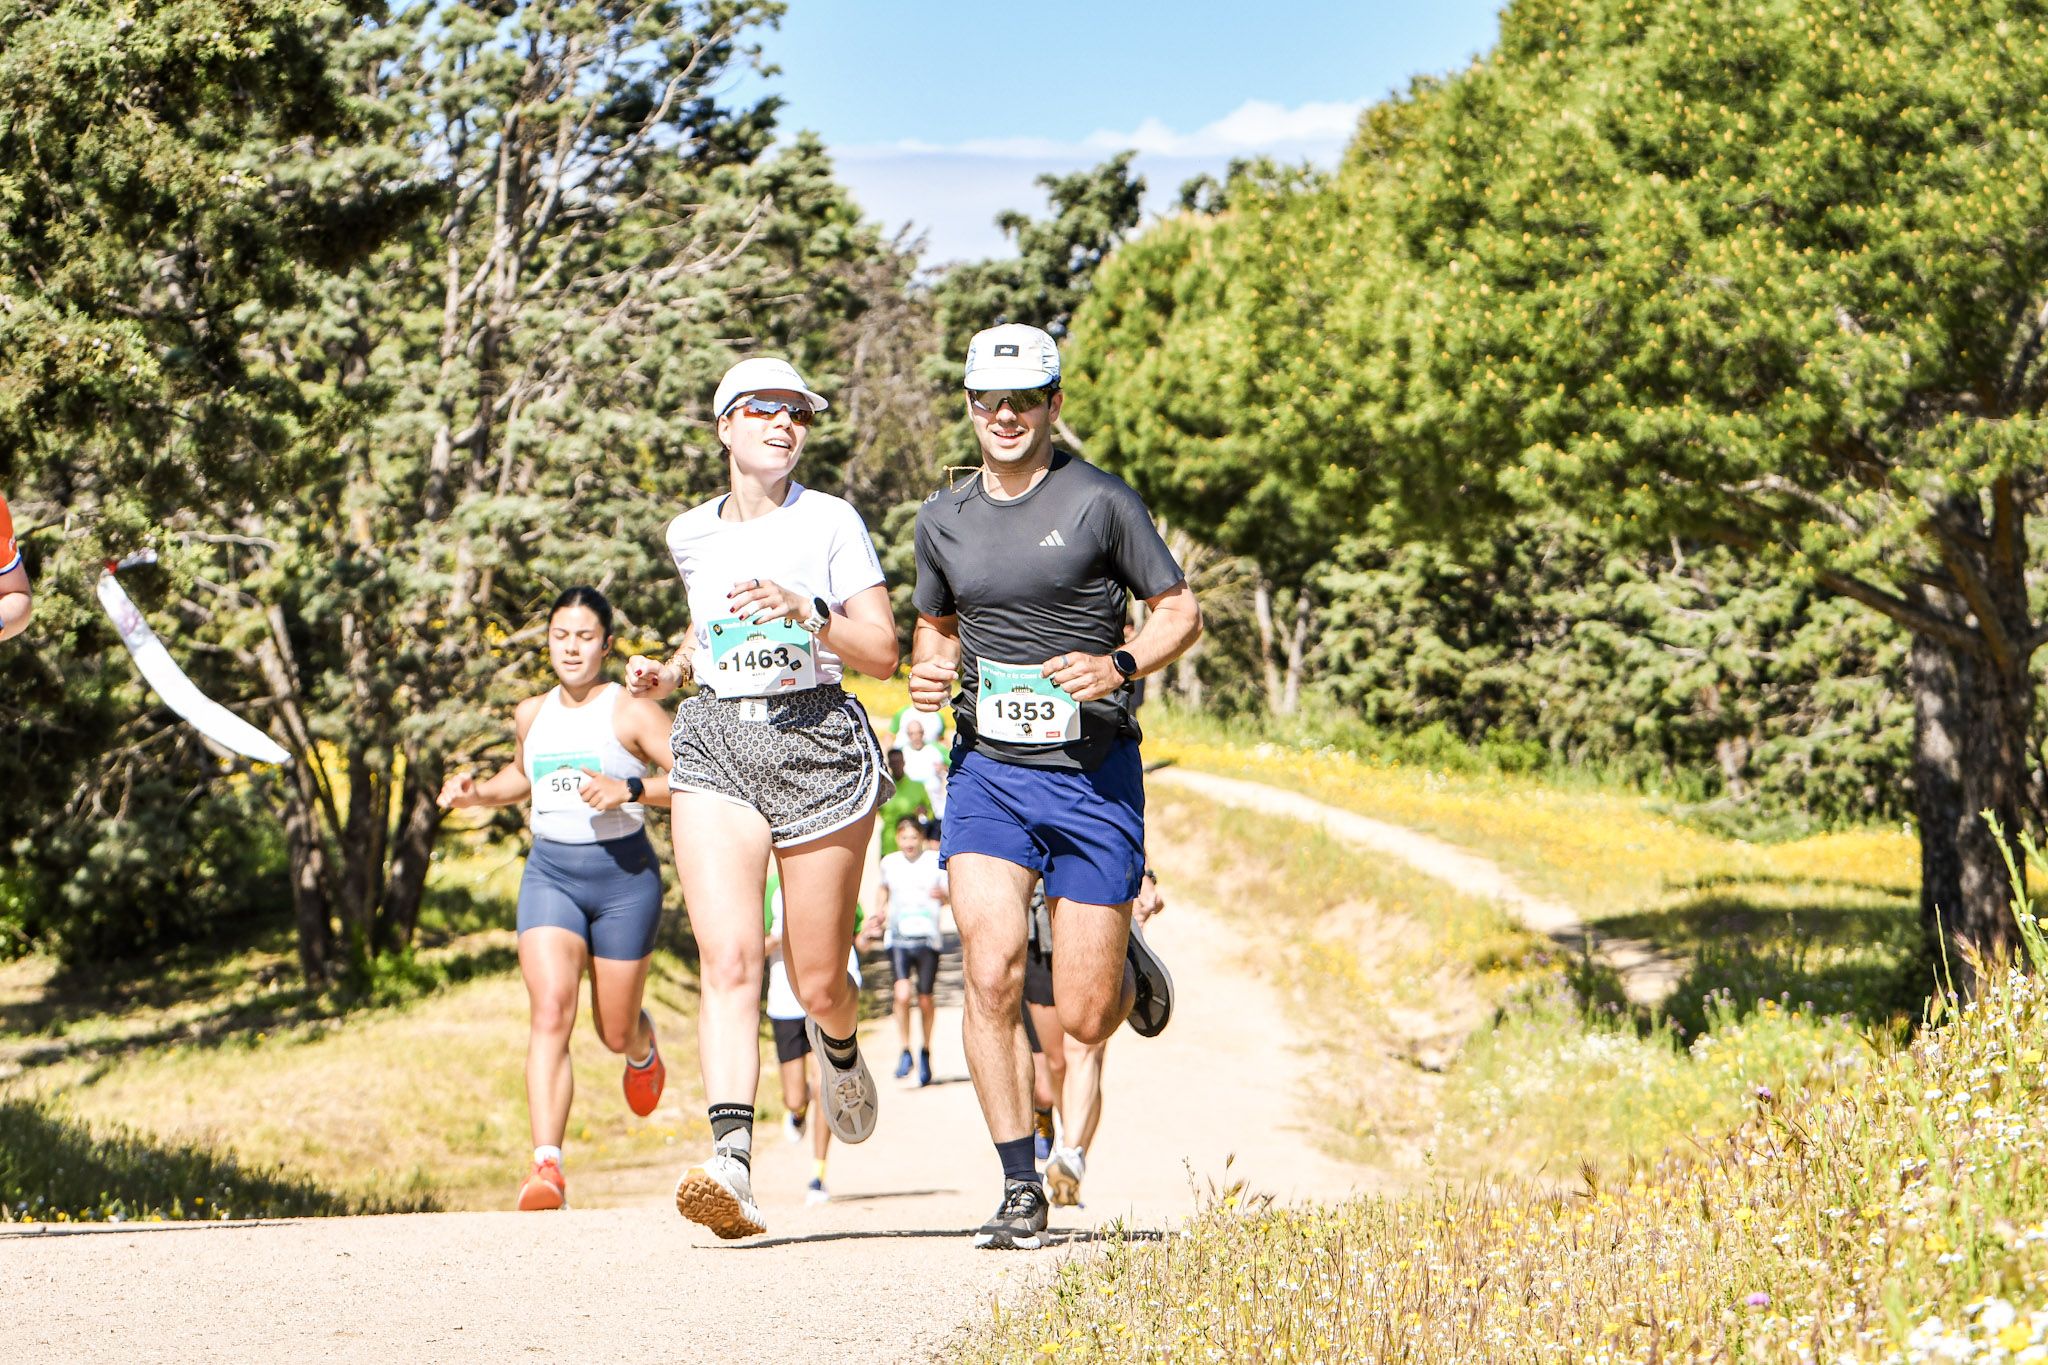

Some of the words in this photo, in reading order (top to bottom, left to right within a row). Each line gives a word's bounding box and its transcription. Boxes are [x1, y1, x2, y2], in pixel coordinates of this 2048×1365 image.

[732, 647, 789, 672] 1463
[995, 699, 1055, 721] 1353
[551, 776, 581, 792] 567
